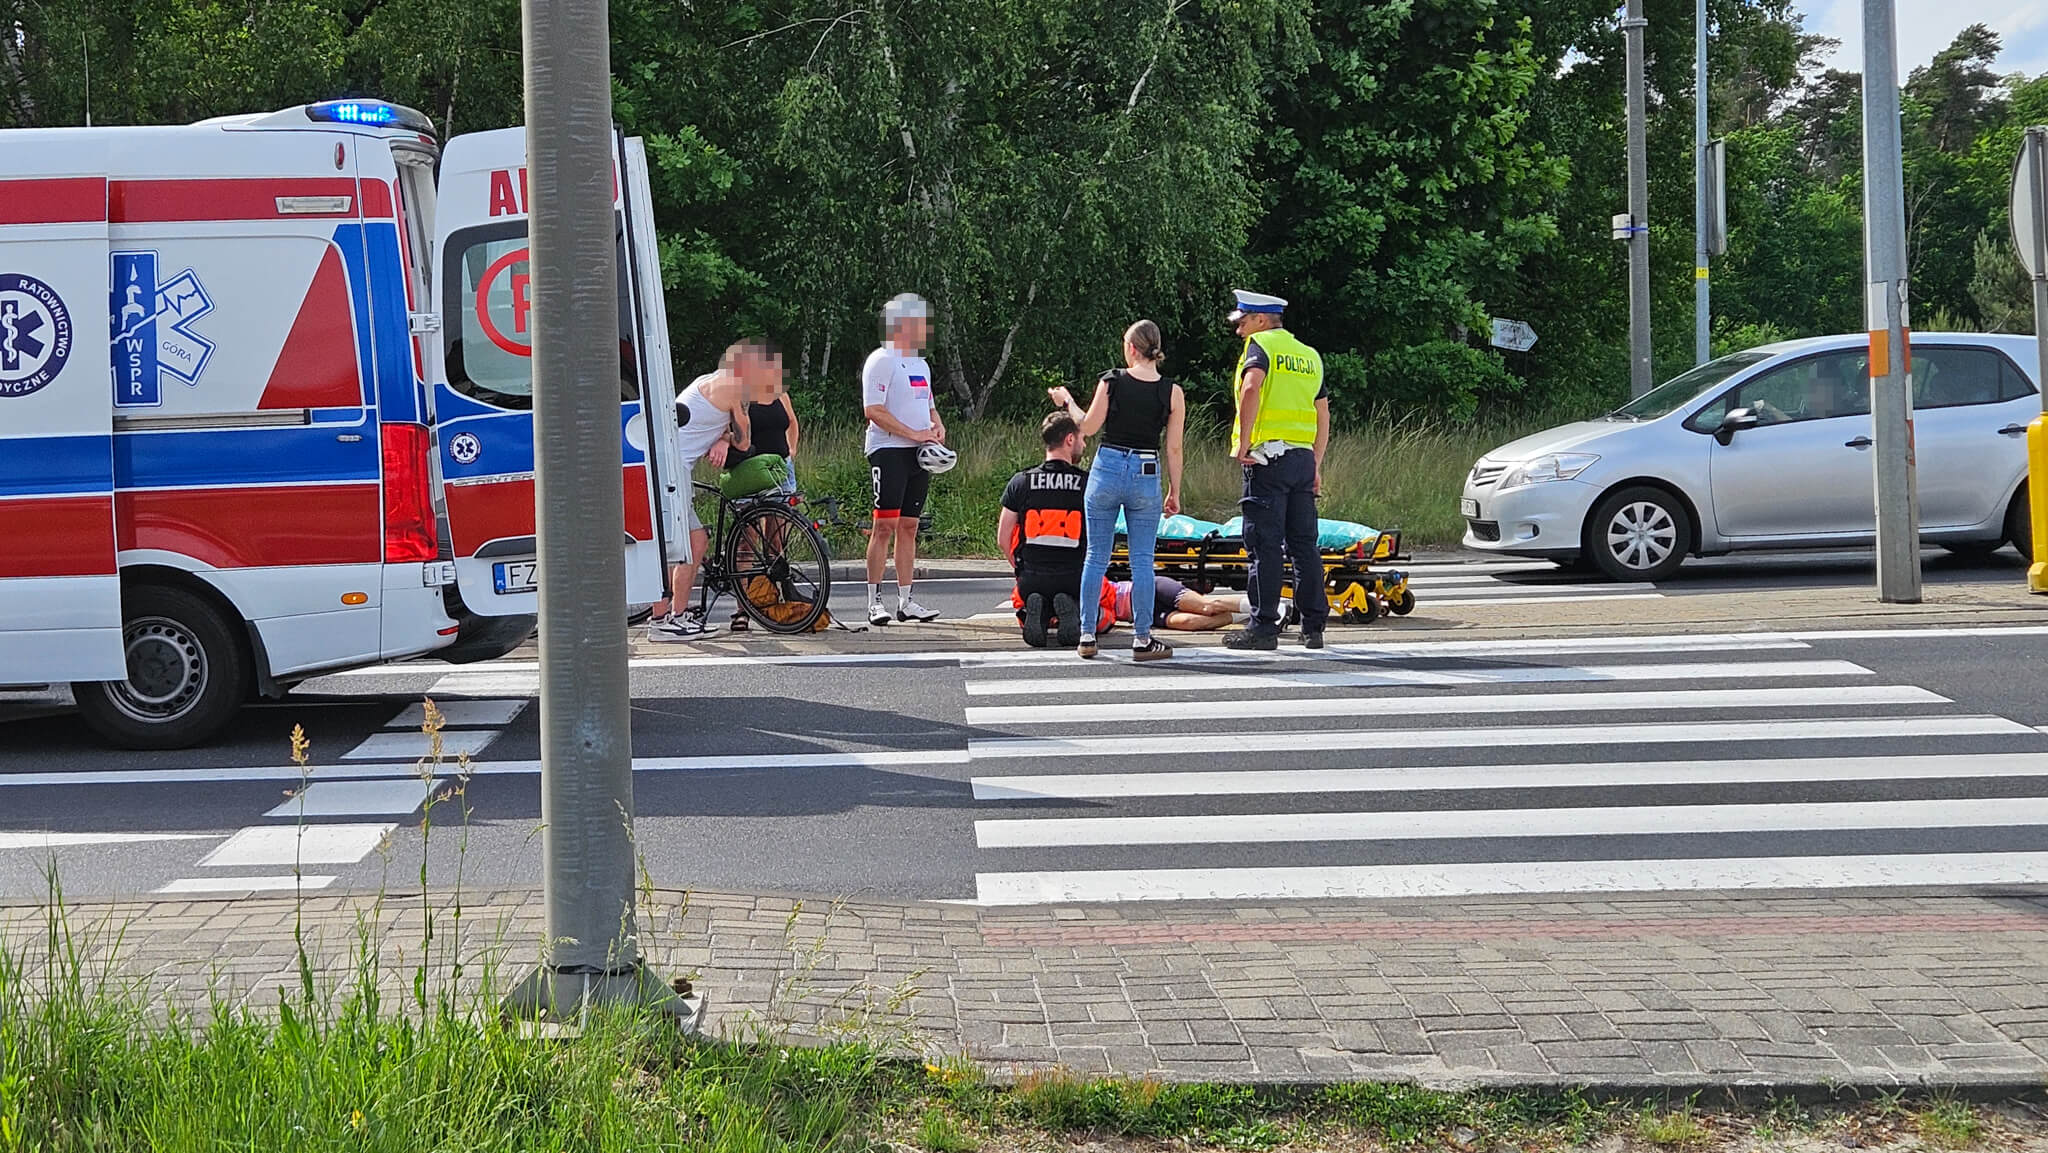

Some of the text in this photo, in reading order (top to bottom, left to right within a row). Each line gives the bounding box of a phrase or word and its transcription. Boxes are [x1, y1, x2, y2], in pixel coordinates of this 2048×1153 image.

[19, 279, 69, 358] RATOWNICTWO
[126, 338, 143, 396] WSPR
[162, 341, 192, 363] GÓRA
[1276, 354, 1316, 376] POLICJA
[871, 466, 882, 509] GCN
[1030, 472, 1081, 491] LEKARZ
